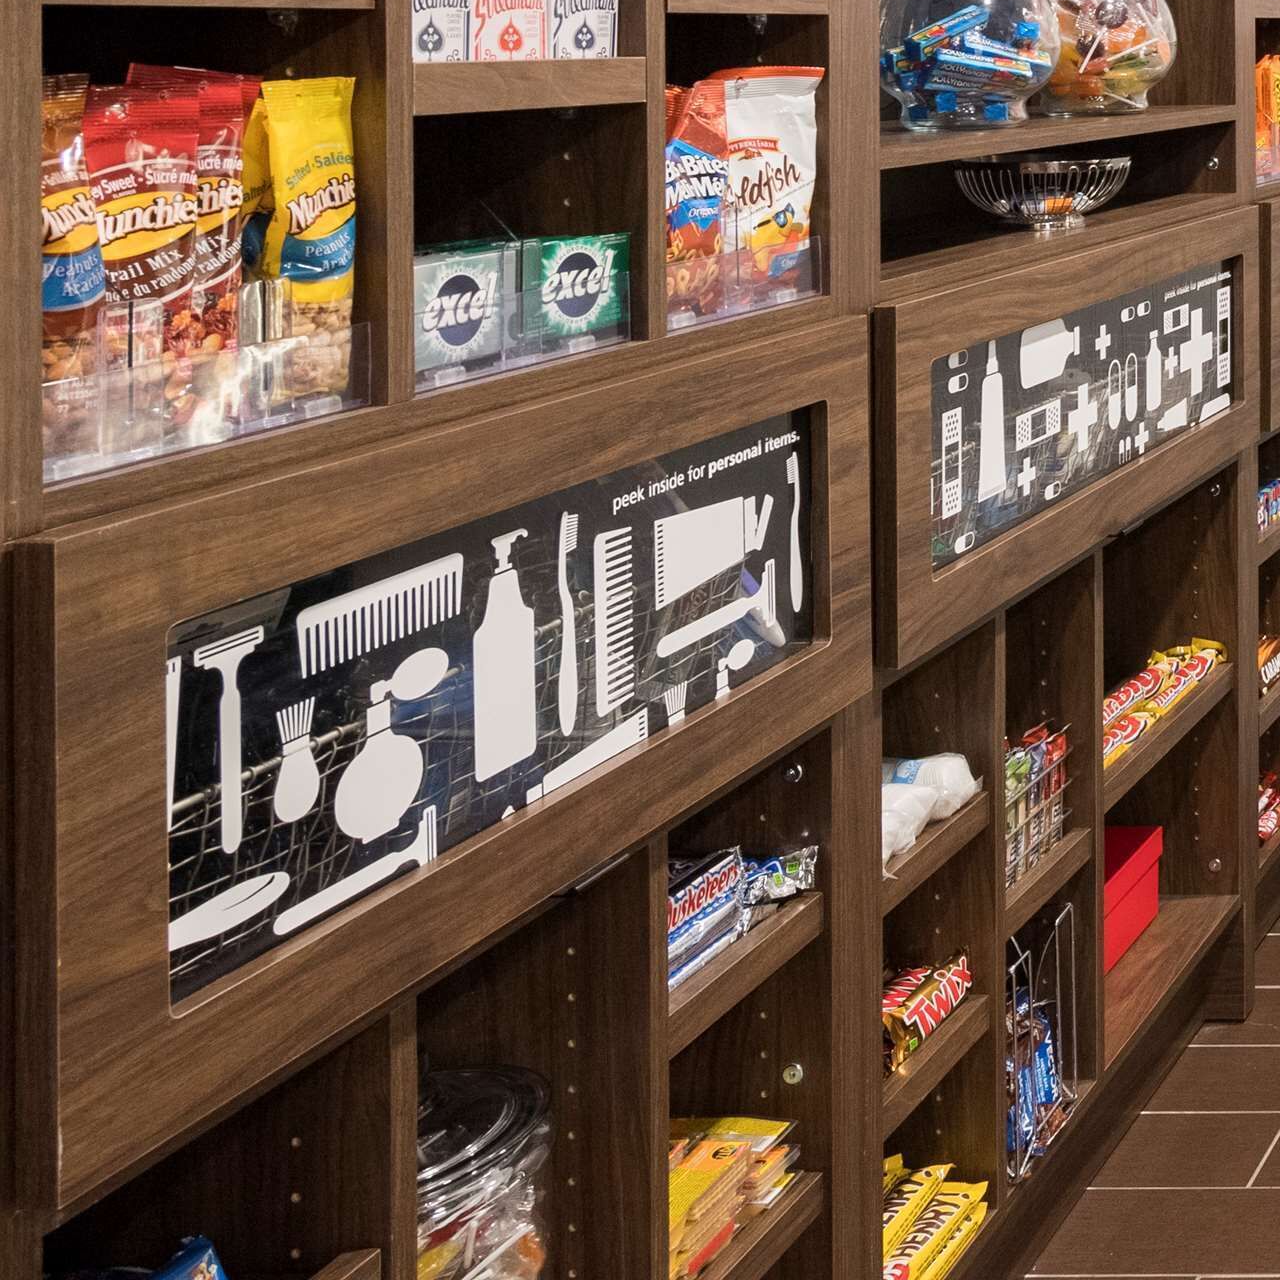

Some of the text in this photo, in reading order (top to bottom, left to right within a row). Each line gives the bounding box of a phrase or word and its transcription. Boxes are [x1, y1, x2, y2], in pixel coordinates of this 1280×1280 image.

[101, 174, 136, 196] Sweet
[145, 168, 177, 186] Sucré
[305, 231, 350, 257] Peanuts
[151, 249, 184, 271] Mix
[133, 283, 150, 298] du
[541, 249, 618, 304] excel
[422, 271, 498, 332] excel
[613, 430, 800, 515] peek inside for personal items.
